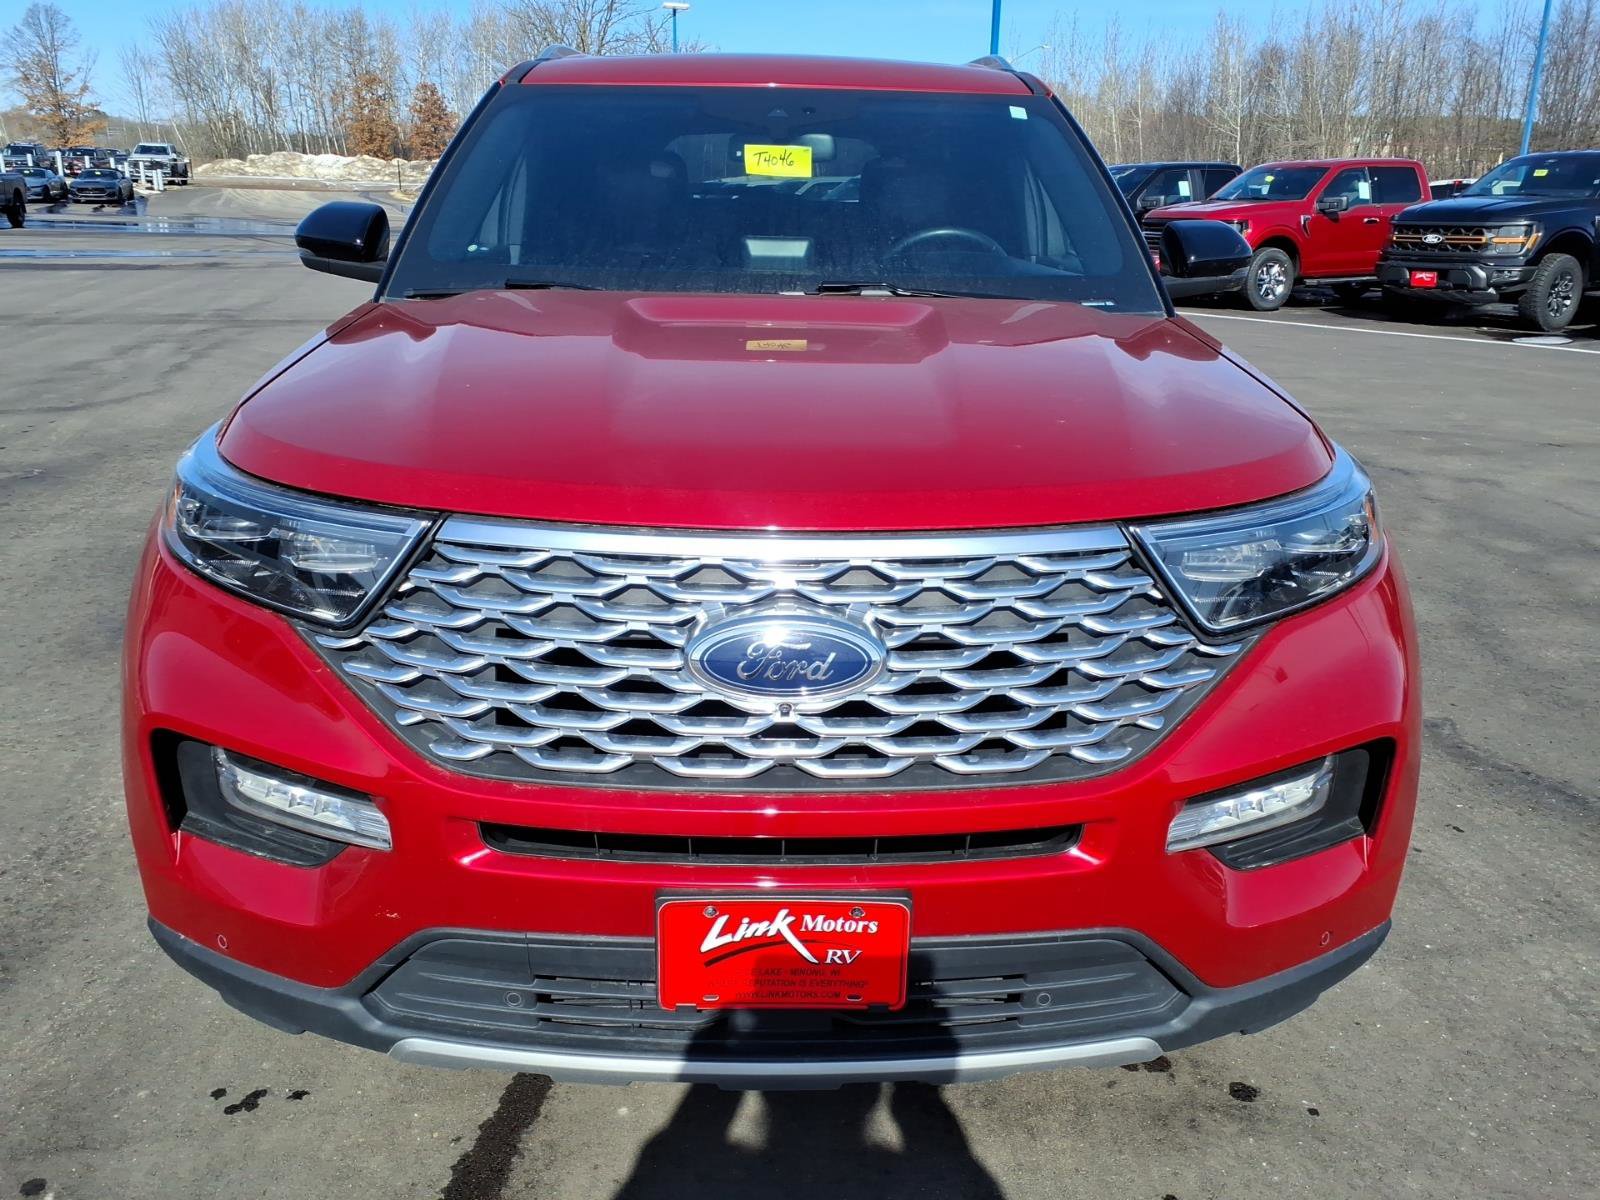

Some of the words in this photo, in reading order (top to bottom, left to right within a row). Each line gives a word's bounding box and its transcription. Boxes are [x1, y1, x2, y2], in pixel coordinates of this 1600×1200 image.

[753, 149, 794, 167] T4046
[737, 641, 837, 681] Ford
[700, 909, 820, 964] Link
[800, 915, 878, 934] Motors
[825, 949, 862, 964] RV
